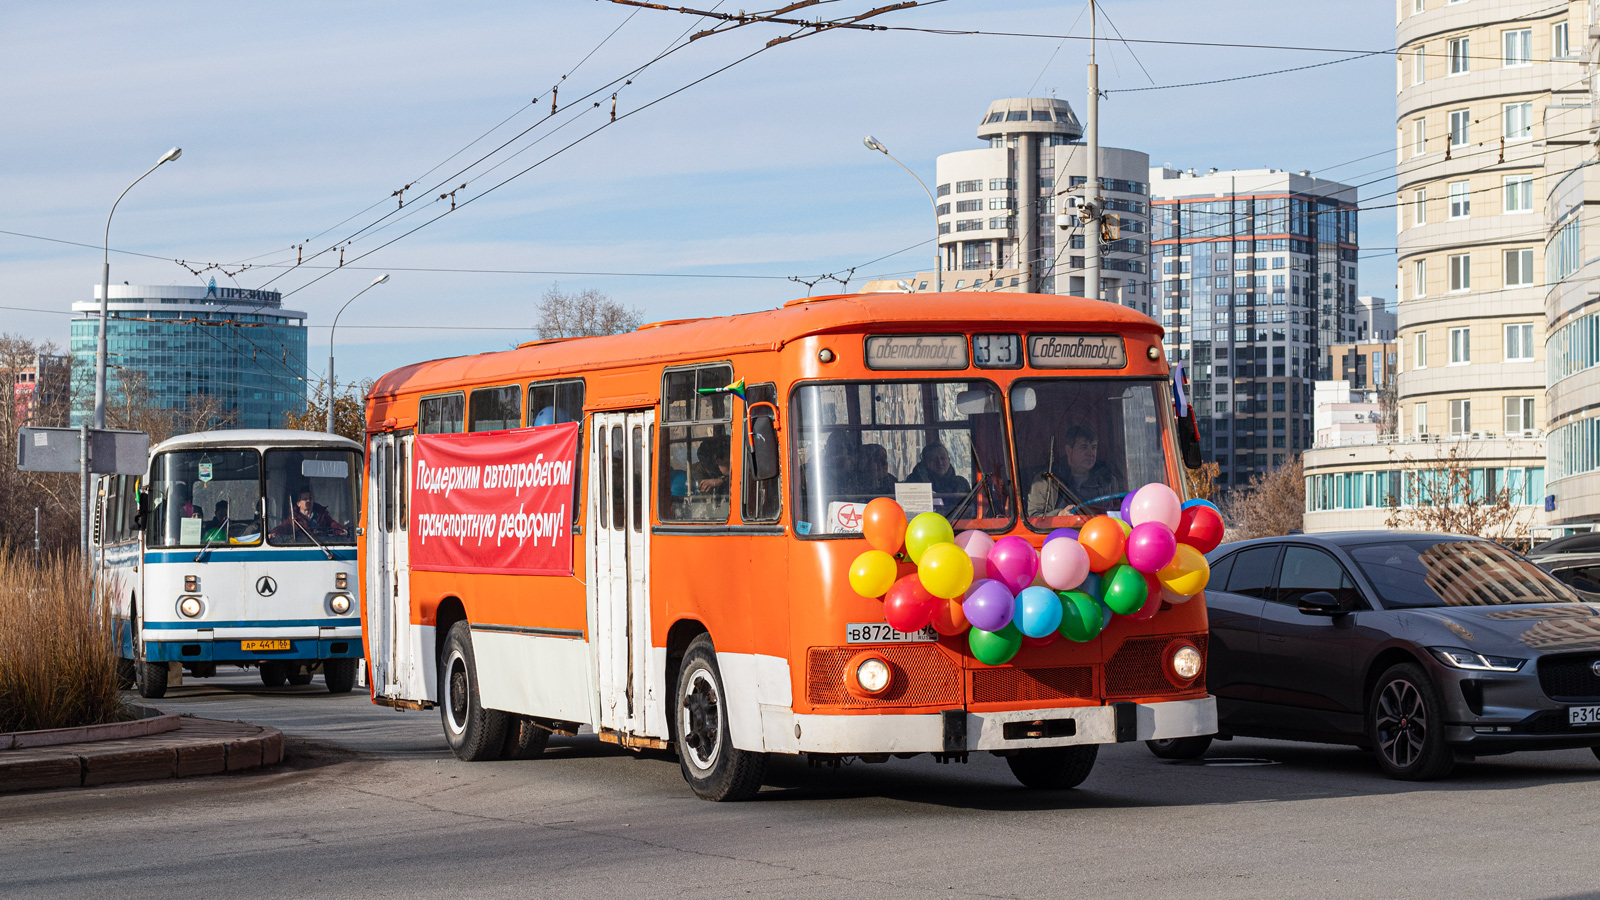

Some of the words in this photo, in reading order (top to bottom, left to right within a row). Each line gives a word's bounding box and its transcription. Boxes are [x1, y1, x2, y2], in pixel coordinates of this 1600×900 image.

[869, 338, 958, 366] Советавтобус
[1032, 337, 1117, 365] Советавтобус
[416, 460, 481, 498] Поддержим
[483, 453, 572, 497] автопробегом
[418, 512, 497, 546] транспортную
[497, 503, 565, 547] реформу!
